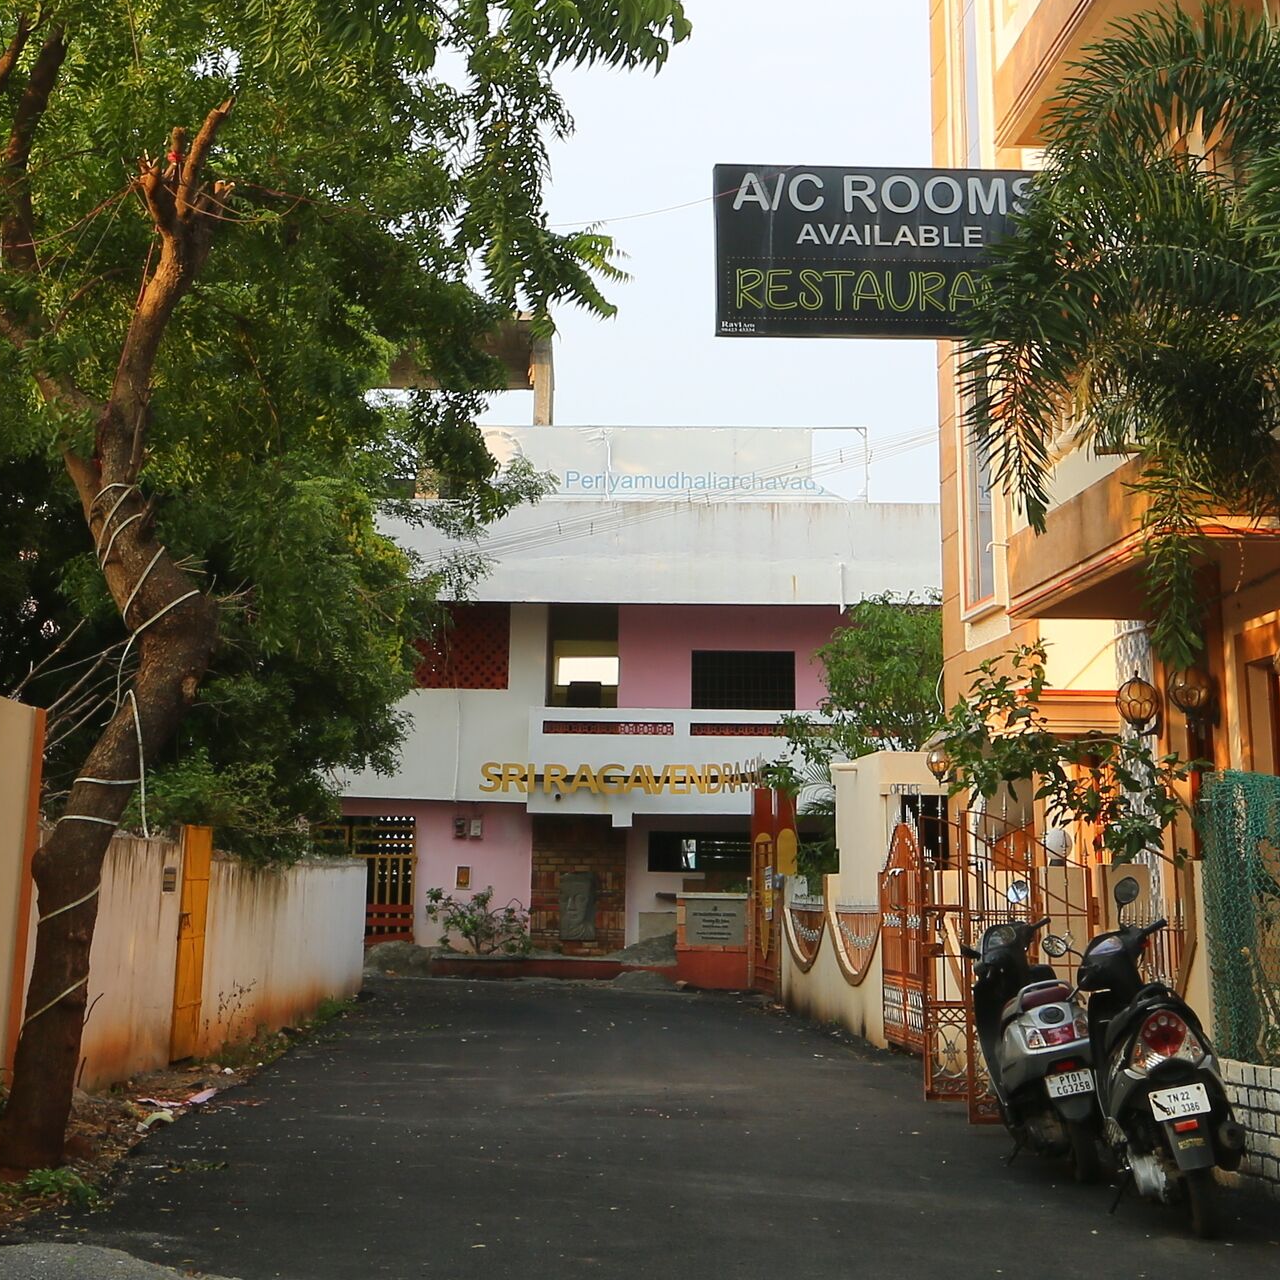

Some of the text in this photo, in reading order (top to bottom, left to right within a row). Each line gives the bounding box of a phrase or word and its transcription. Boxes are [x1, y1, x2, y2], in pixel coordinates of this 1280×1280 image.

[732, 172, 1041, 216] A/C ROOMS
[796, 224, 984, 248] AVAILABLE
[479, 762, 536, 794] SRI
[543, 762, 743, 795] RAGAVENDRA
[890, 783, 922, 795] OFFICE
[1059, 1072, 1082, 1085] PY01
